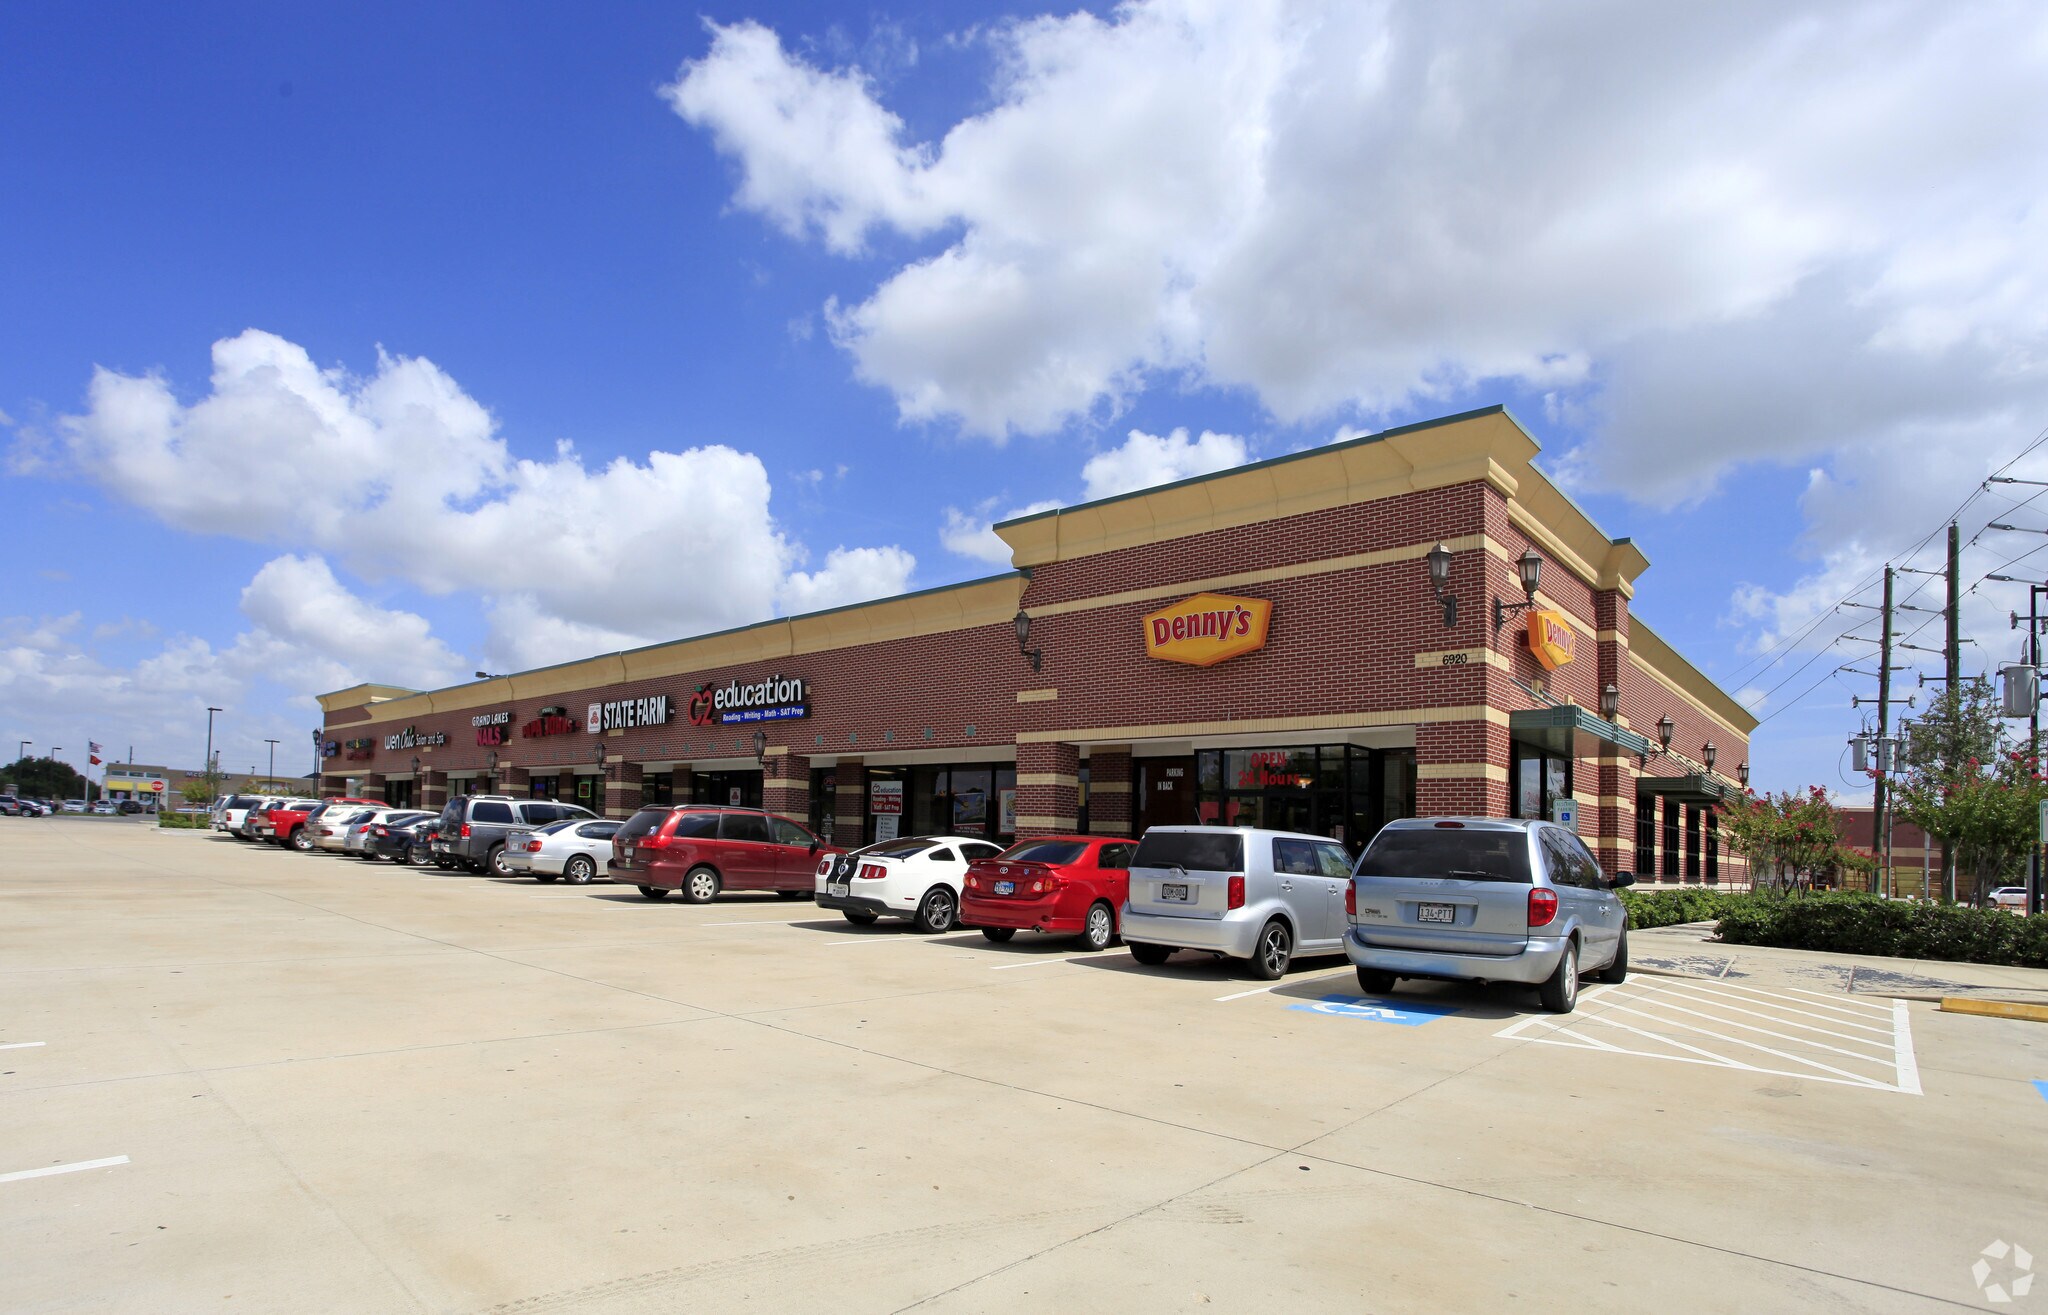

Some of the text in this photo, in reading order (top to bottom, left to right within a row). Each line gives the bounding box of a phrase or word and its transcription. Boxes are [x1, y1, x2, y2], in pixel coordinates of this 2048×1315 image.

[1151, 604, 1252, 648] Denny's
[1545, 617, 1575, 659] Denny's
[1442, 653, 1467, 665] 6920
[687, 674, 802, 726] C2 education
[471, 712, 509, 726] GRAND LAKES
[603, 695, 666, 729] STATE FARM
[722, 707, 804, 722] Reading Writing Math SAT Prep
[400, 728, 416, 749] Chic
[475, 726, 501, 747] NAILS
[1251, 751, 1287, 768] OPEN
[1166, 768, 1184, 777] PARKING
[1238, 771, 1300, 787] 24 Hours
[1157, 781, 1174, 791] IN BACK
